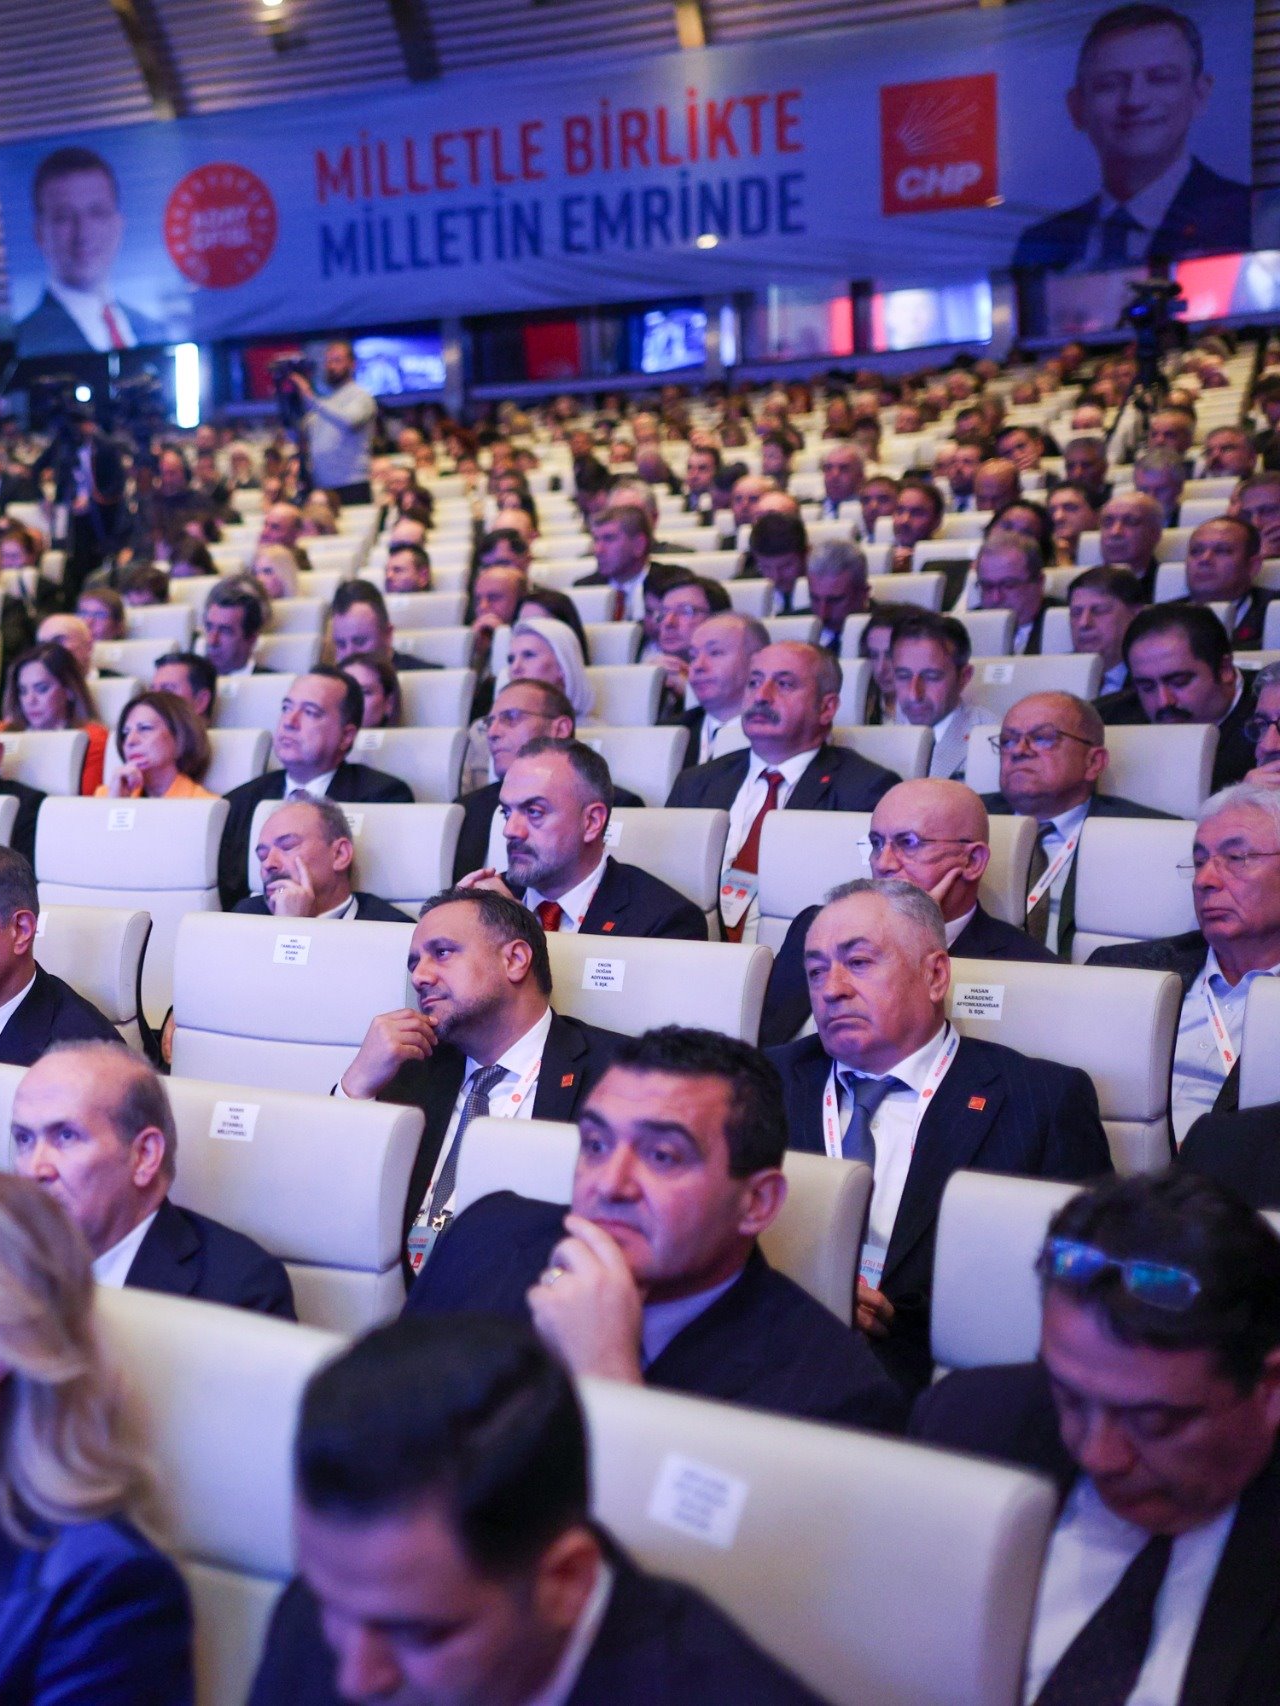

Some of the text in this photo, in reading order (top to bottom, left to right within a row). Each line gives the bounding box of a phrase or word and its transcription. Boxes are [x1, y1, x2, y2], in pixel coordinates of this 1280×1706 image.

[316, 87, 805, 206] MİLLETLE BİRLİKTE
[896, 161, 983, 200] CHP
[320, 188, 543, 279] MİLLETİN
[559, 169, 806, 254] EMRİNDE
